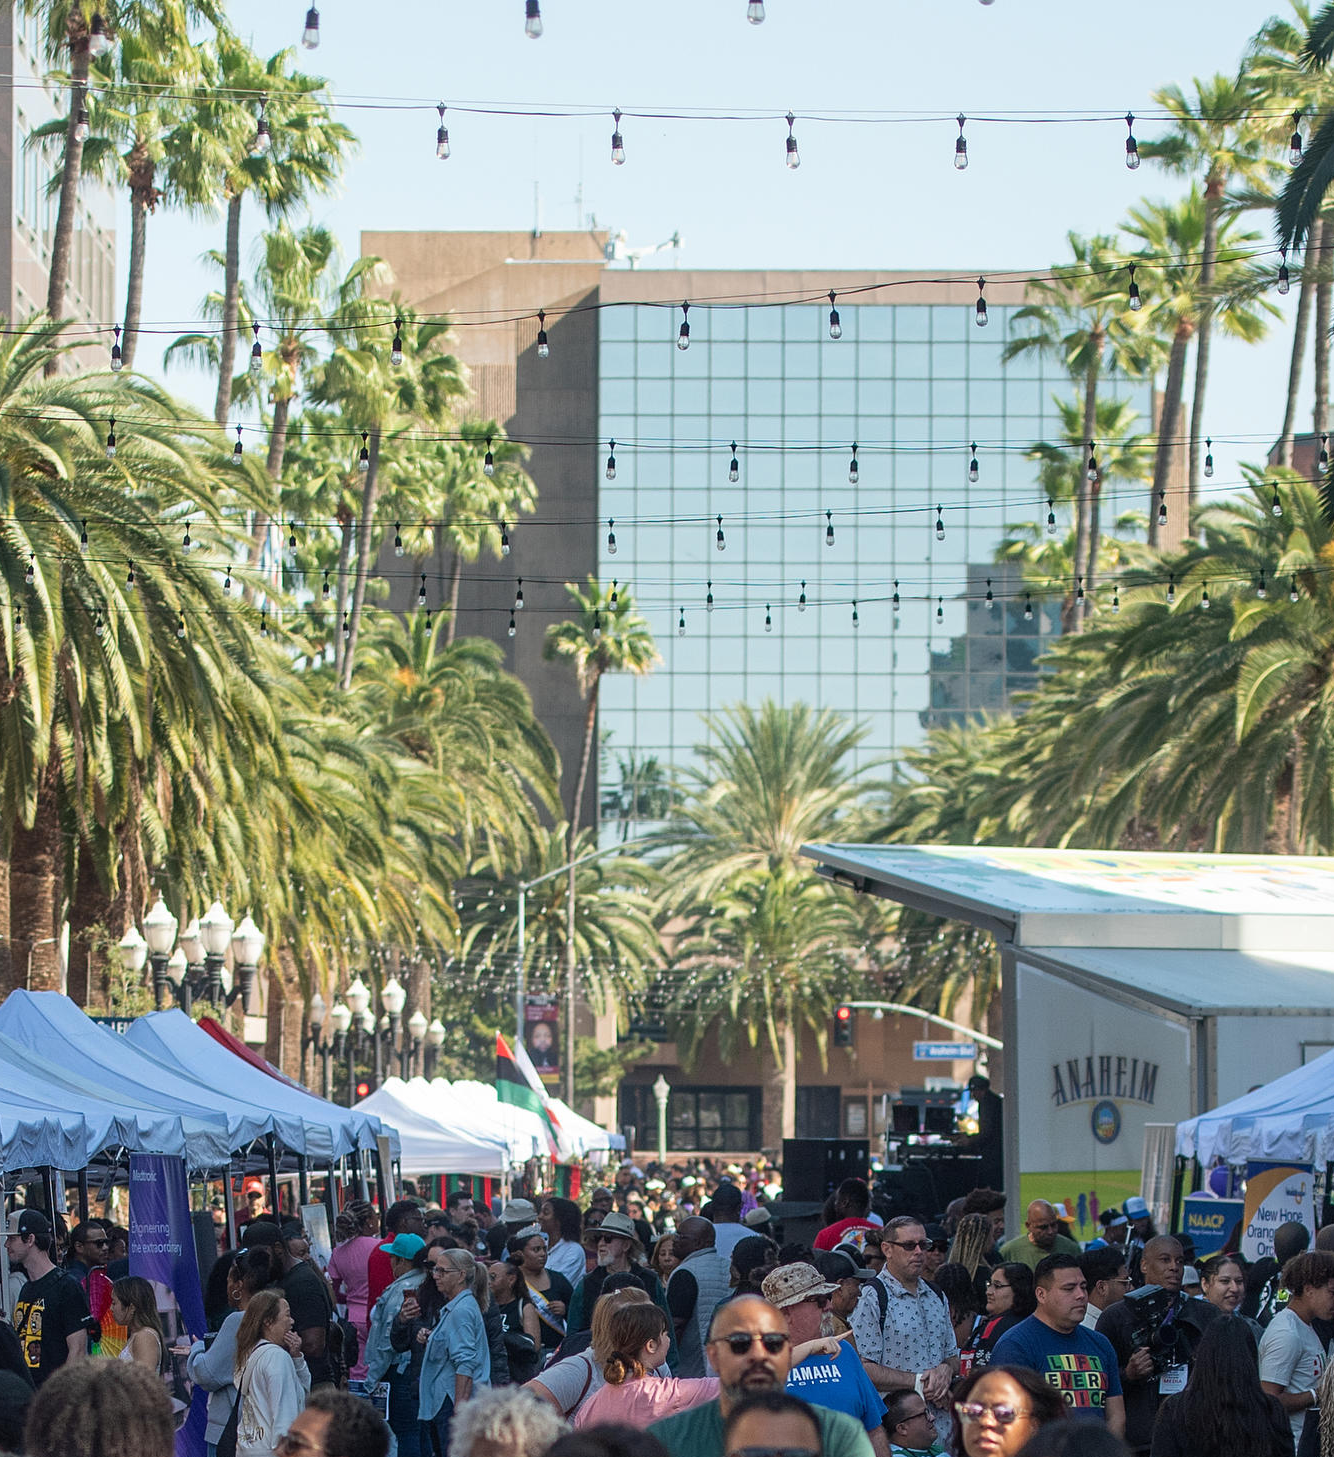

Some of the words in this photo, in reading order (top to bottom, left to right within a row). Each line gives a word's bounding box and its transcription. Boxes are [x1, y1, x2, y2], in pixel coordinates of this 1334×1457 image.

[1051, 1054, 1159, 1107] ANAHEIM
[132, 1169, 157, 1182] Medtronic
[1188, 1213, 1225, 1229] NAACP
[1258, 1207, 1277, 1221] New
[1279, 1207, 1304, 1223] Hope
[1049, 1355, 1101, 1370] LIFT
[1047, 1373, 1108, 1388] EVERY
